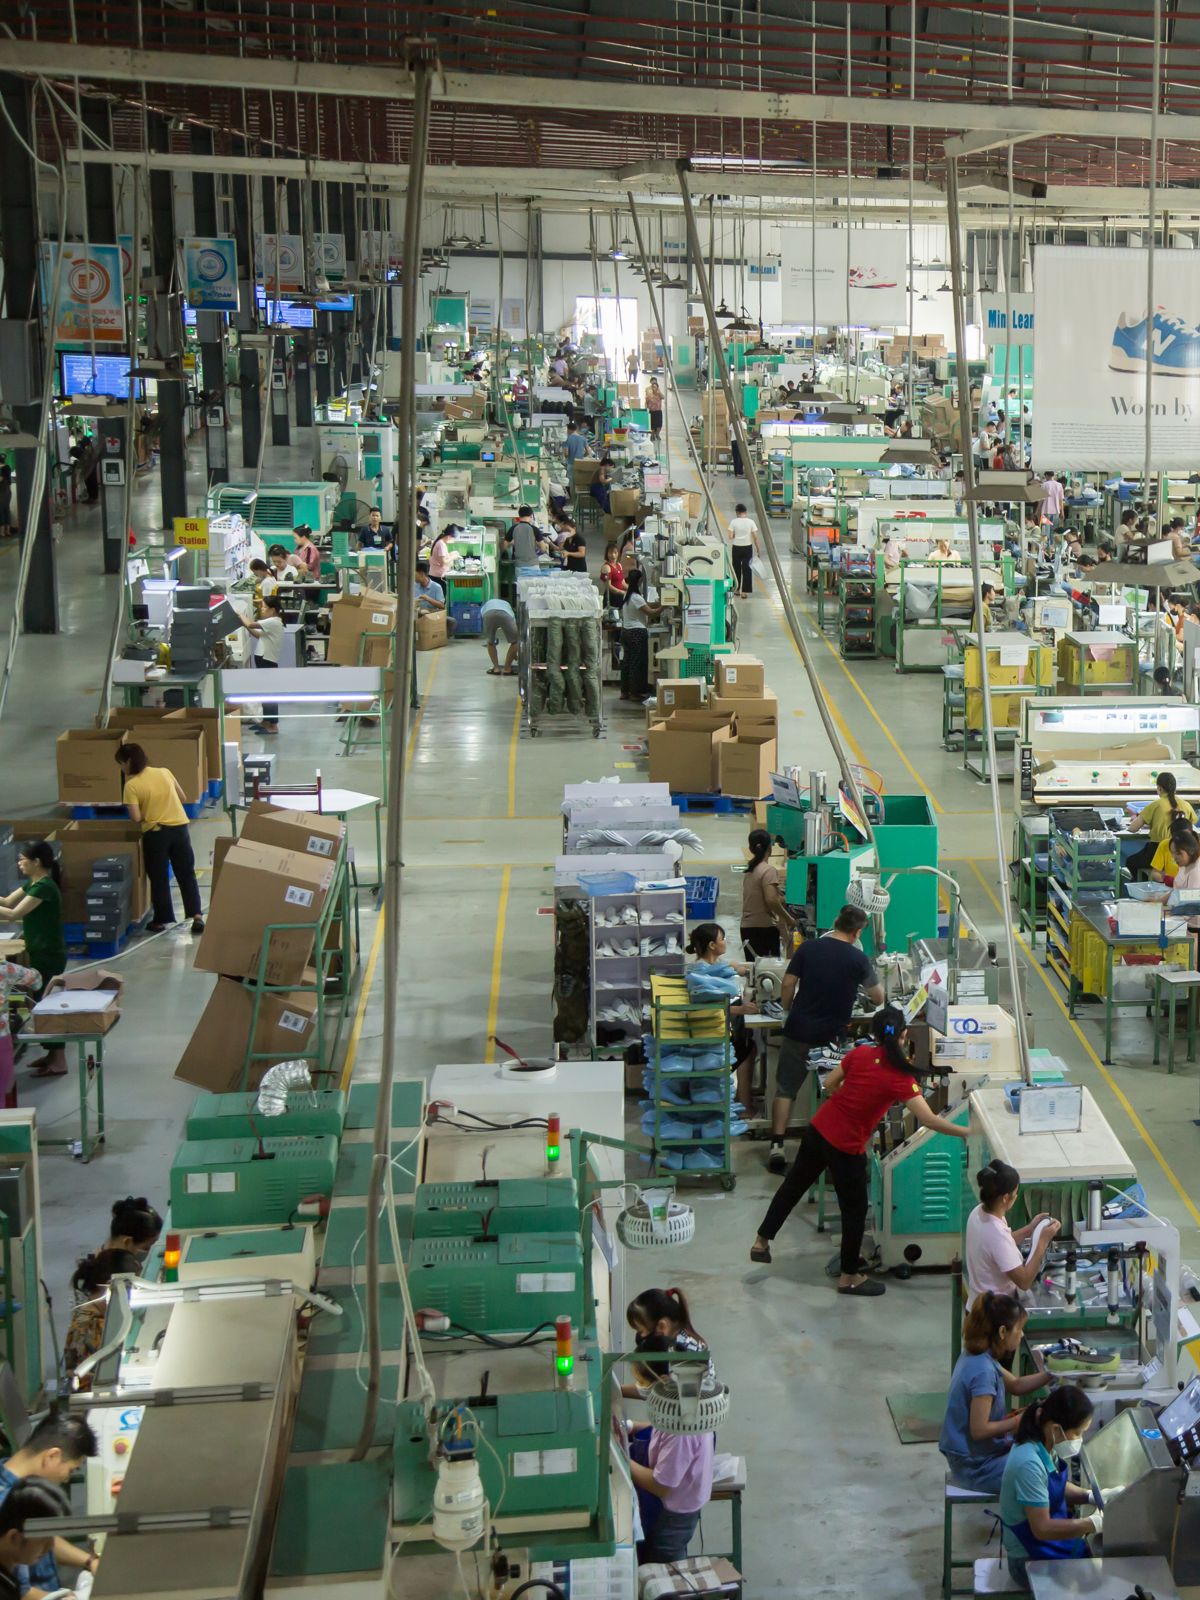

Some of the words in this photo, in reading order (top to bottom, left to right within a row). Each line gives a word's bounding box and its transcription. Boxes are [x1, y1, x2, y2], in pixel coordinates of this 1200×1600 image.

[988, 309, 1008, 329] Min
[1111, 396, 1166, 416] Won
[184, 522, 200, 531] EOL
[178, 536, 207, 545] Station
